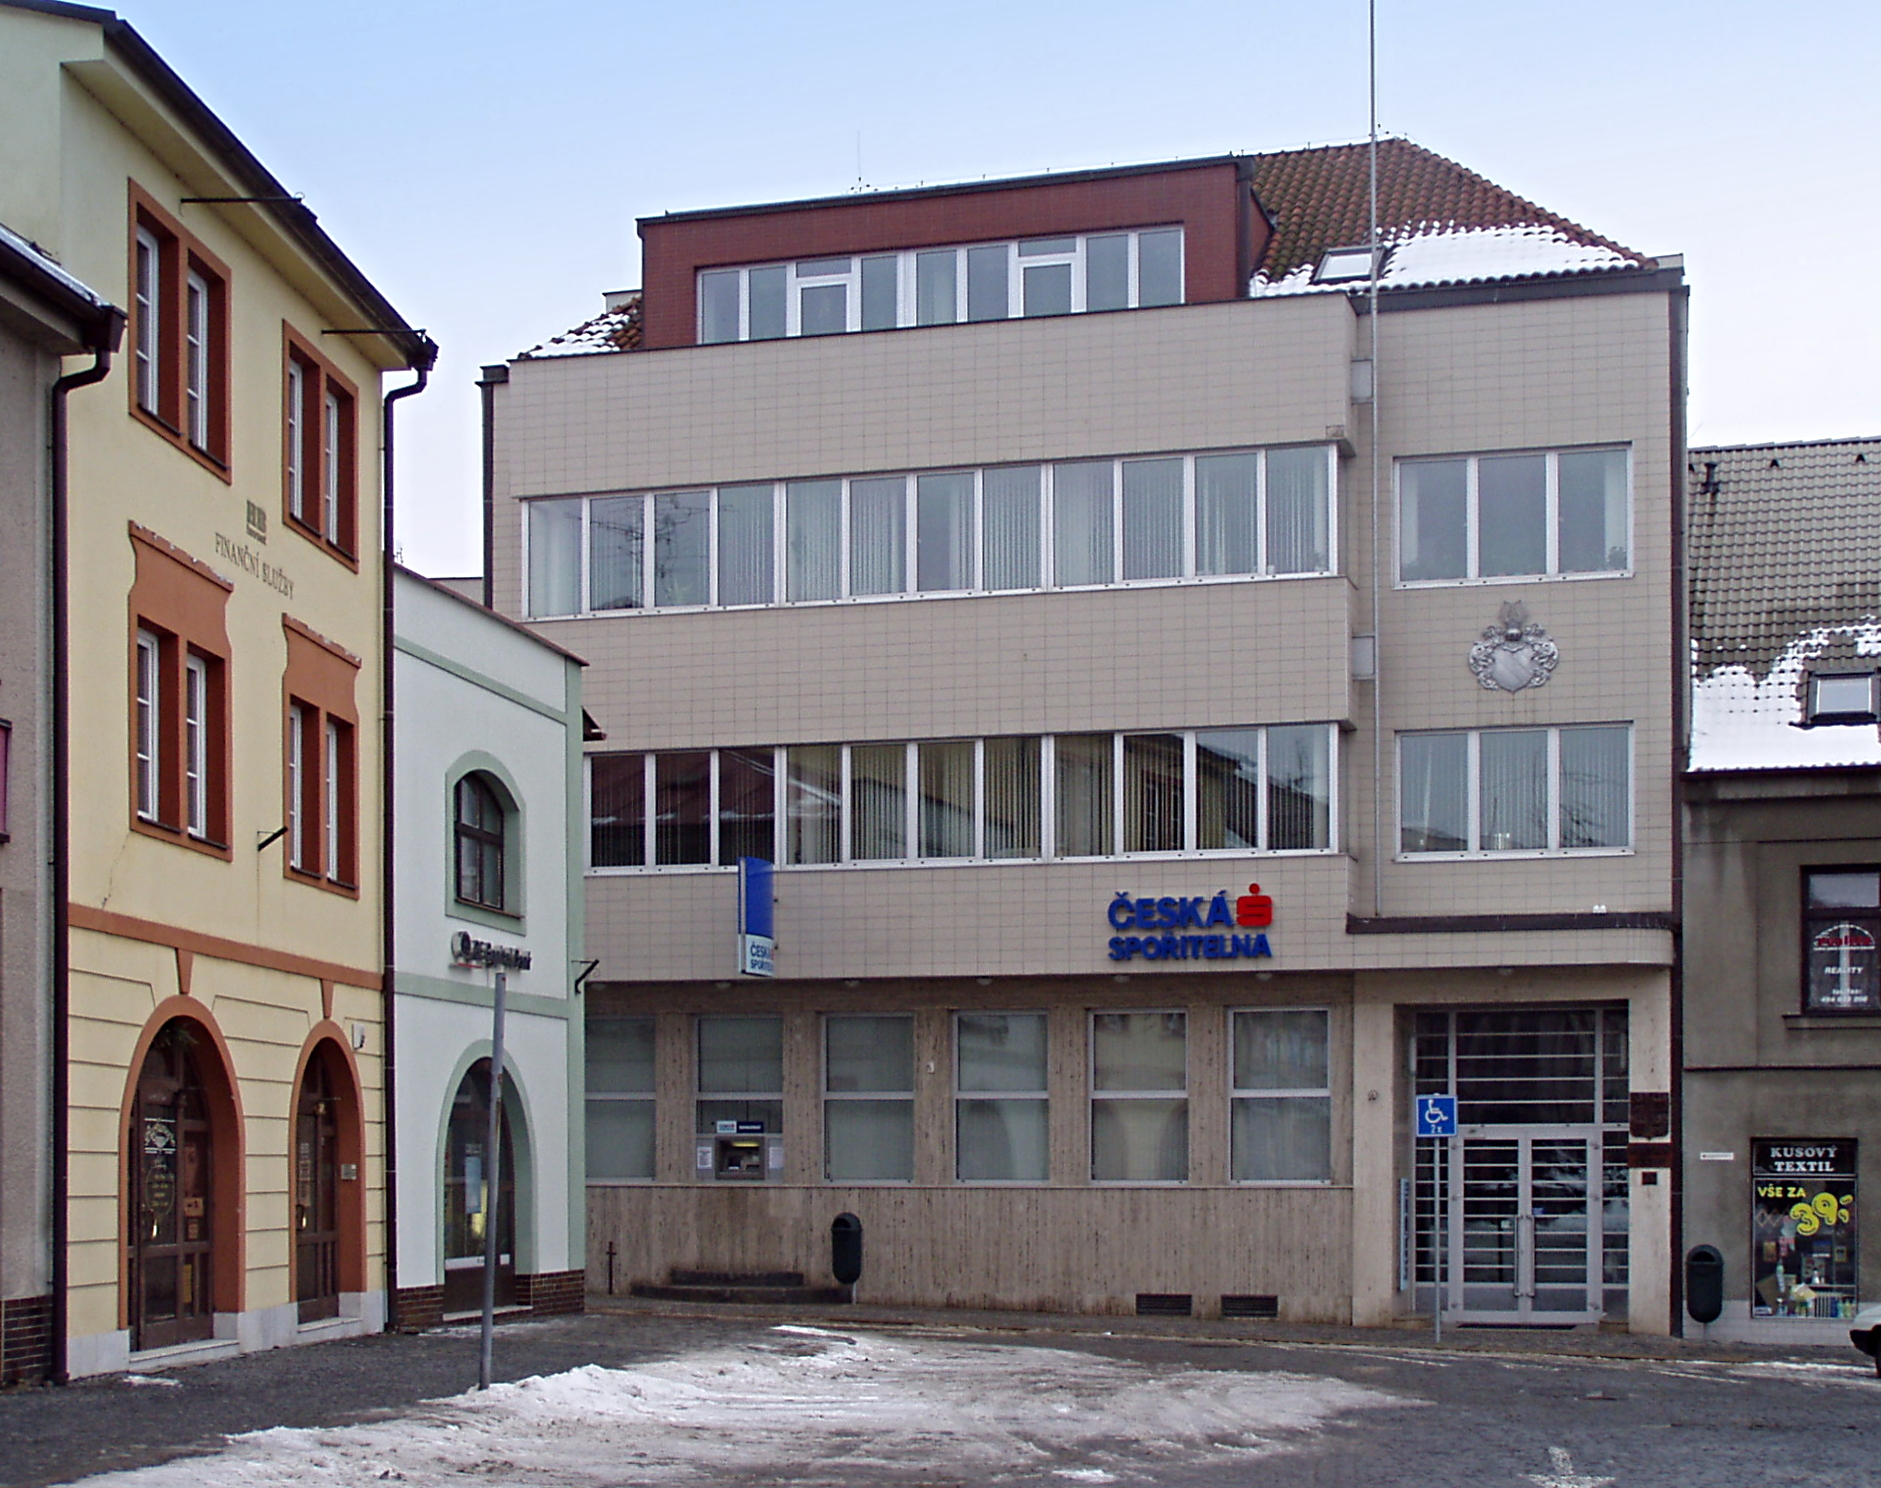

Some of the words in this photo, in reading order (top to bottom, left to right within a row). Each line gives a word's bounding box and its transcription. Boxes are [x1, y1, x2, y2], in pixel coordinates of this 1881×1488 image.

[216, 532, 259, 578] FINANČNÍ
[1108, 890, 1234, 930] ČESKÁ
[1108, 930, 1272, 961] SPOŘITELNA
[1770, 1145, 1837, 1158] KUSOVÝ
[1774, 1161, 1834, 1172] TEXTIL
[1758, 1183, 1783, 1198] VŠE
[1786, 1187, 1806, 1198] ZA
